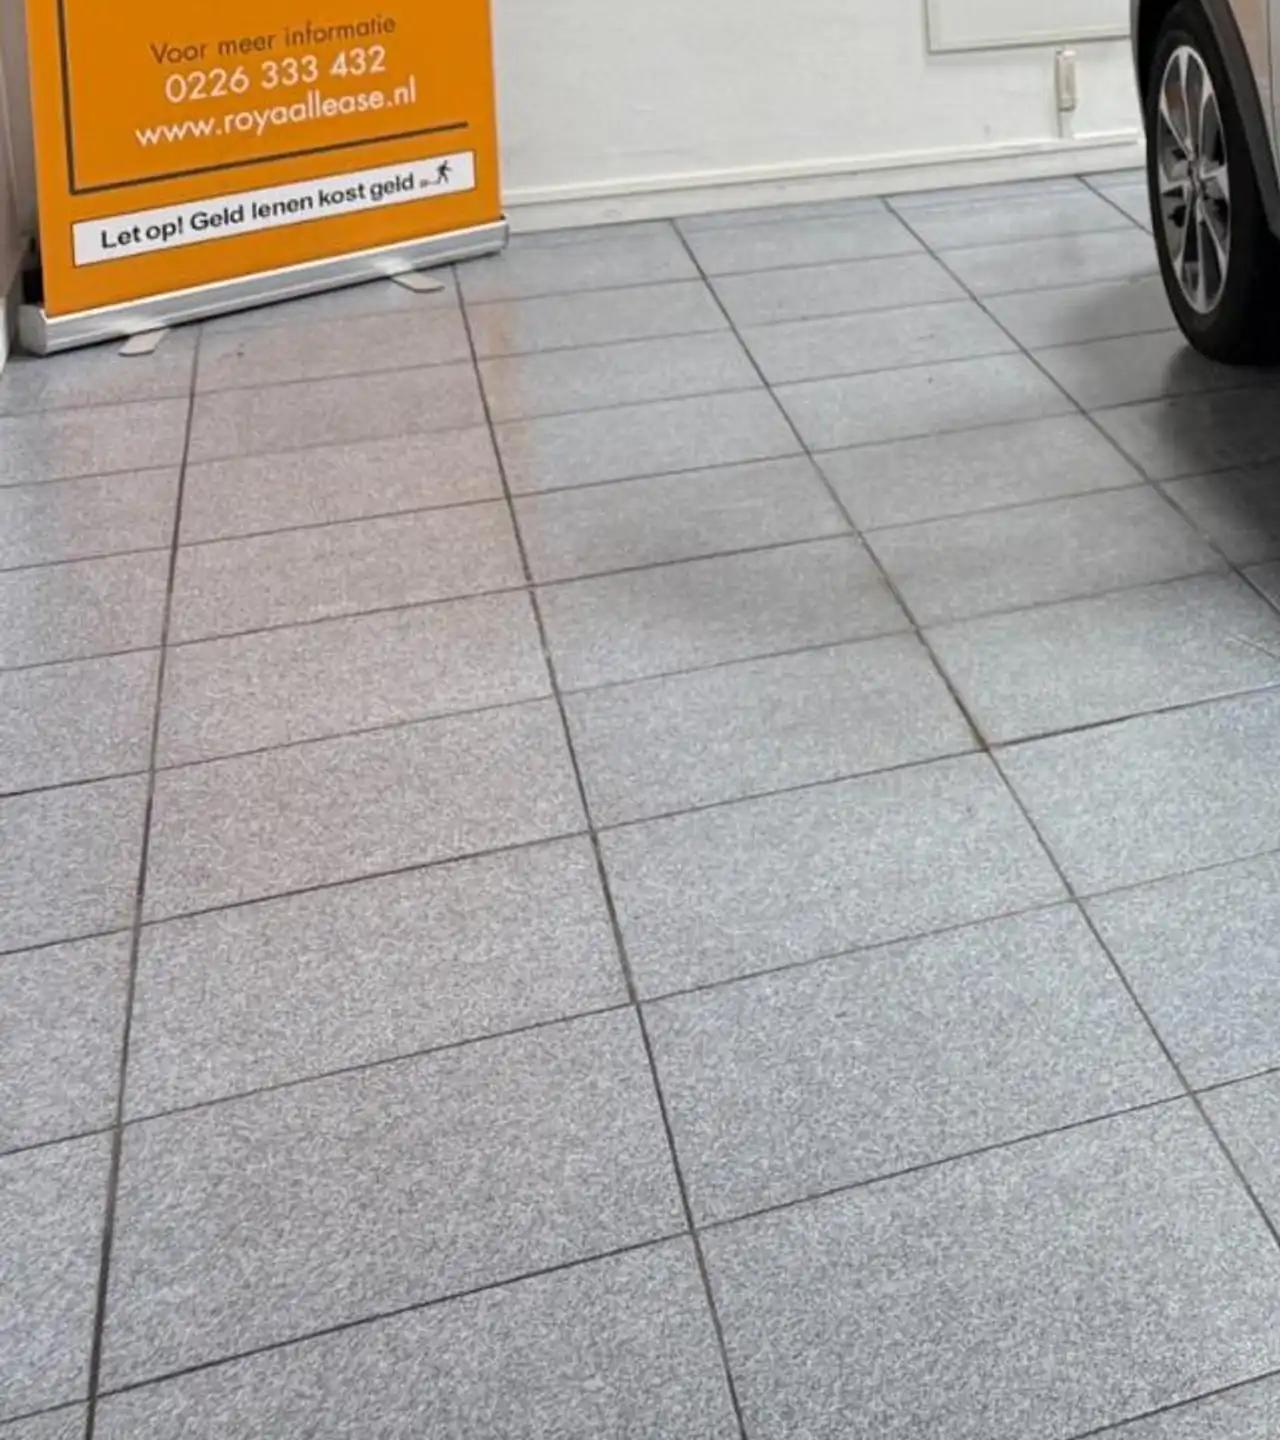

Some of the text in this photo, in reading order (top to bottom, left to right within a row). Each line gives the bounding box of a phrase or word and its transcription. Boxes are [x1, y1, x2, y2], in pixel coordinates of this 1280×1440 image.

[150, 14, 397, 66] Voor meer informatie
[165, 44, 388, 105] 0226 333 432
[135, 73, 418, 148] www.royaallease.nl
[101, 171, 416, 250] Let op! Geld lenen kost geld
